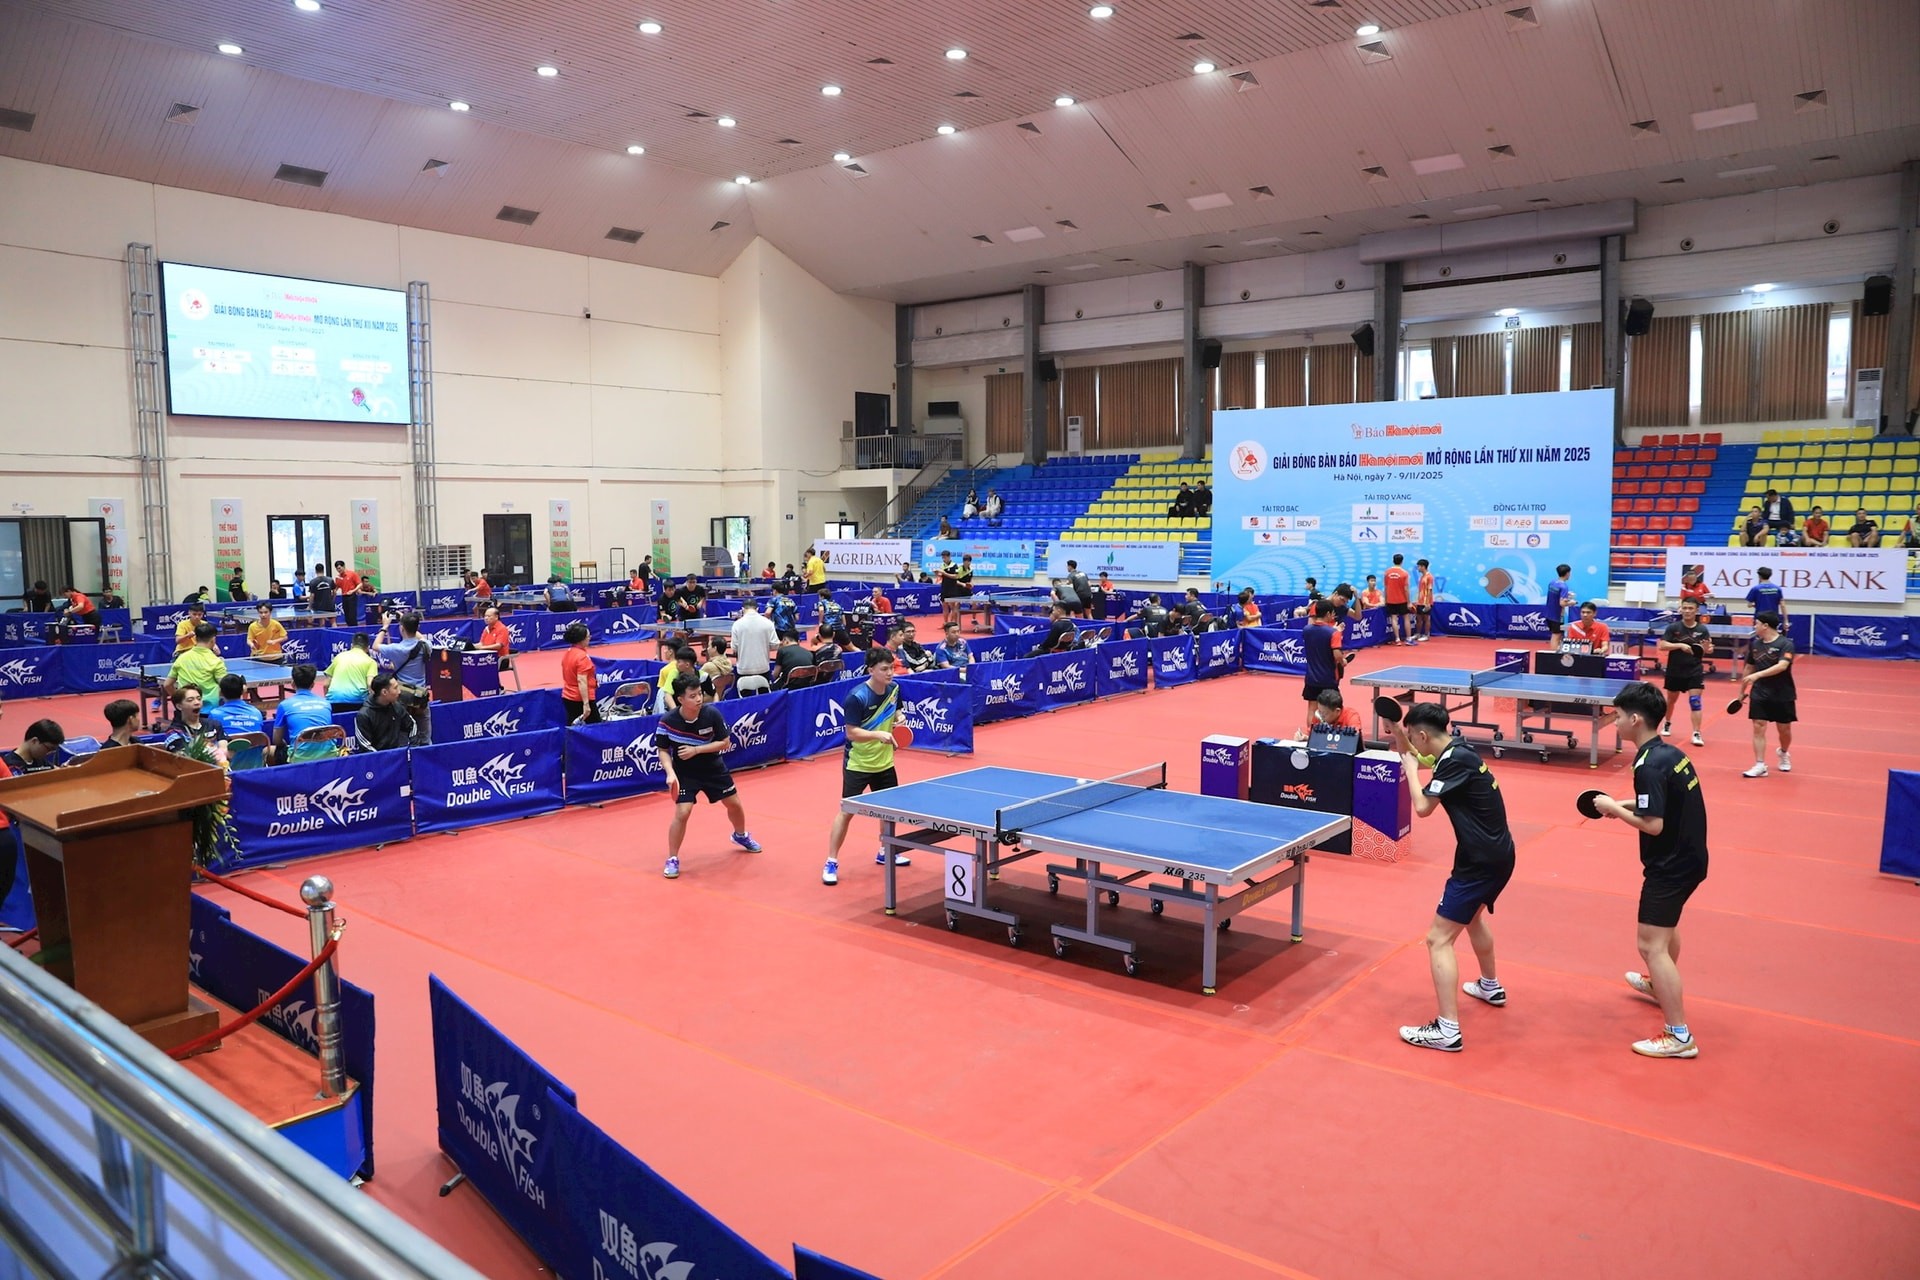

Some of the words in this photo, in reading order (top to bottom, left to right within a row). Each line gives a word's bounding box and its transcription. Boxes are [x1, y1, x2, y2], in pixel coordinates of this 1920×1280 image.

[1365, 426, 1385, 437] Báo
[1273, 452, 1290, 469] GIẢI
[1293, 453, 1316, 468] BÓNG
[1318, 452, 1336, 468] BÀN
[1339, 451, 1357, 467] BÁO
[1426, 447, 1442, 465] MỞ
[1445, 448, 1471, 468] RỘNG
[1497, 446, 1517, 463] THỨ
[1519, 448, 1533, 463] XII
[1536, 445, 1561, 462] NĂM
[1564, 447, 1590, 462] 2025
[1364, 474, 1385, 482] ngày
[1399, 472, 1443, 480] 9/11/2025
[833, 553, 902, 566] AGRIBANK
[1712, 569, 1888, 590] AGIBANK
[1611, 644, 1623, 654] 10
[1258, 653, 1283, 663] Double
[23, 675, 42, 684] FISH
[1046, 684, 1067, 695] Double
[1074, 681, 1086, 691] FISH
[1421, 685, 1459, 694] MOFIT
[1012, 692, 1025, 701] FISH
[935, 723, 953, 733] FISH
[747, 734, 767, 746] FISH
[593, 766, 633, 782] Double
[648, 761, 664, 772] FIS
[446, 788, 492, 808] Double
[509, 781, 535, 795] FISH
[267, 816, 325, 838] Double
[348, 807, 378, 824] FISH
[932, 821, 988, 837] MOFIT
[952, 865, 966, 896] 8
[1188, 871, 1205, 881] 235
[457, 1100, 498, 1161] Double
[519, 1165, 545, 1210] FISH
[600, 1208, 639, 1280] 双魚
